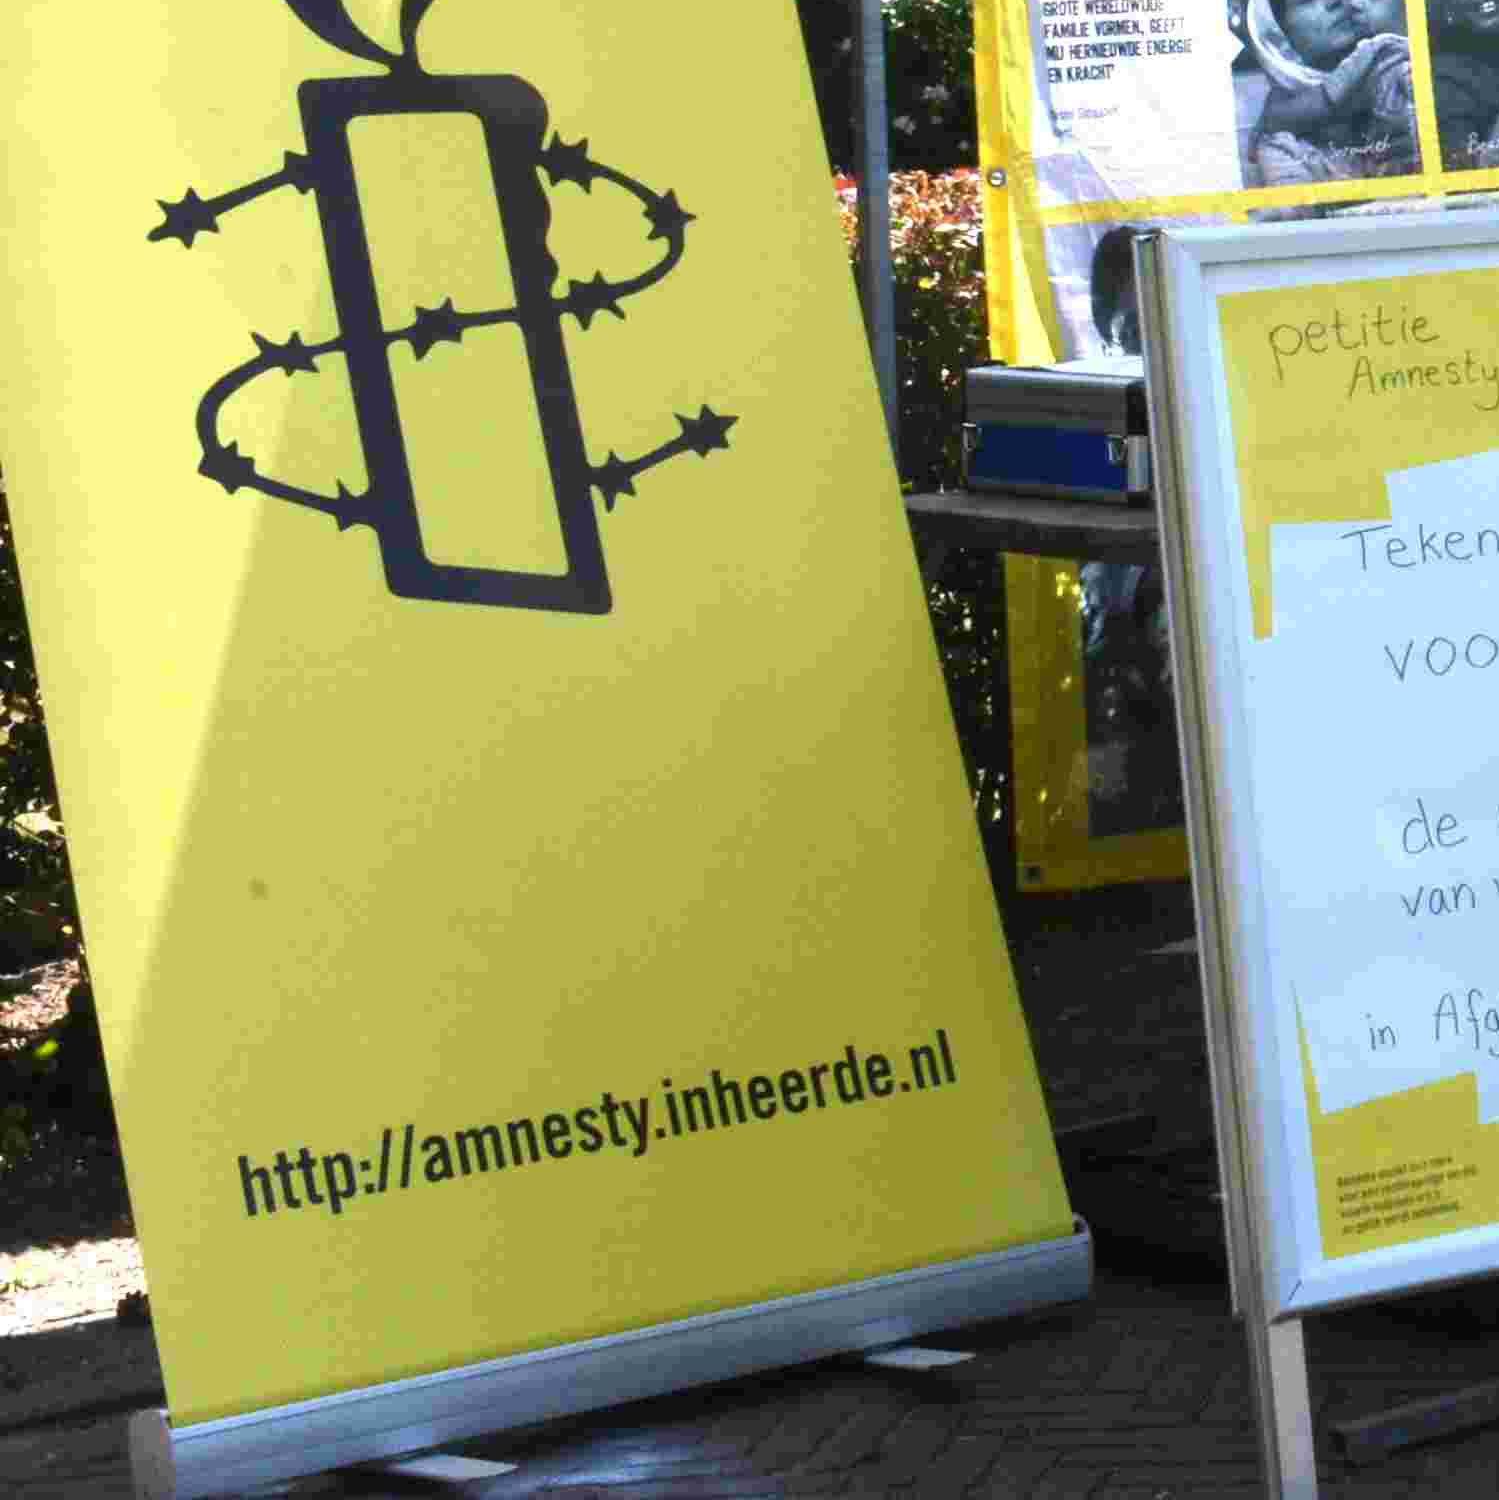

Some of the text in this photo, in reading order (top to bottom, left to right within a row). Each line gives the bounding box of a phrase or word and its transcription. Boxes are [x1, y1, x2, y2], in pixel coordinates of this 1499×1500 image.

[1042, 0, 1079, 17] GROTE
[1041, 20, 1089, 38] FAMILIE
[1146, 38, 1193, 57] ENERGIE
[1047, 66, 1063, 84] EN
[1268, 307, 1440, 382] petitie
[1401, 796, 1469, 856] de
[1401, 879, 1478, 918] van
[1366, 1009, 1397, 1051] in
[237, 1028, 959, 1217] http://amnesty.inheerde.nl
